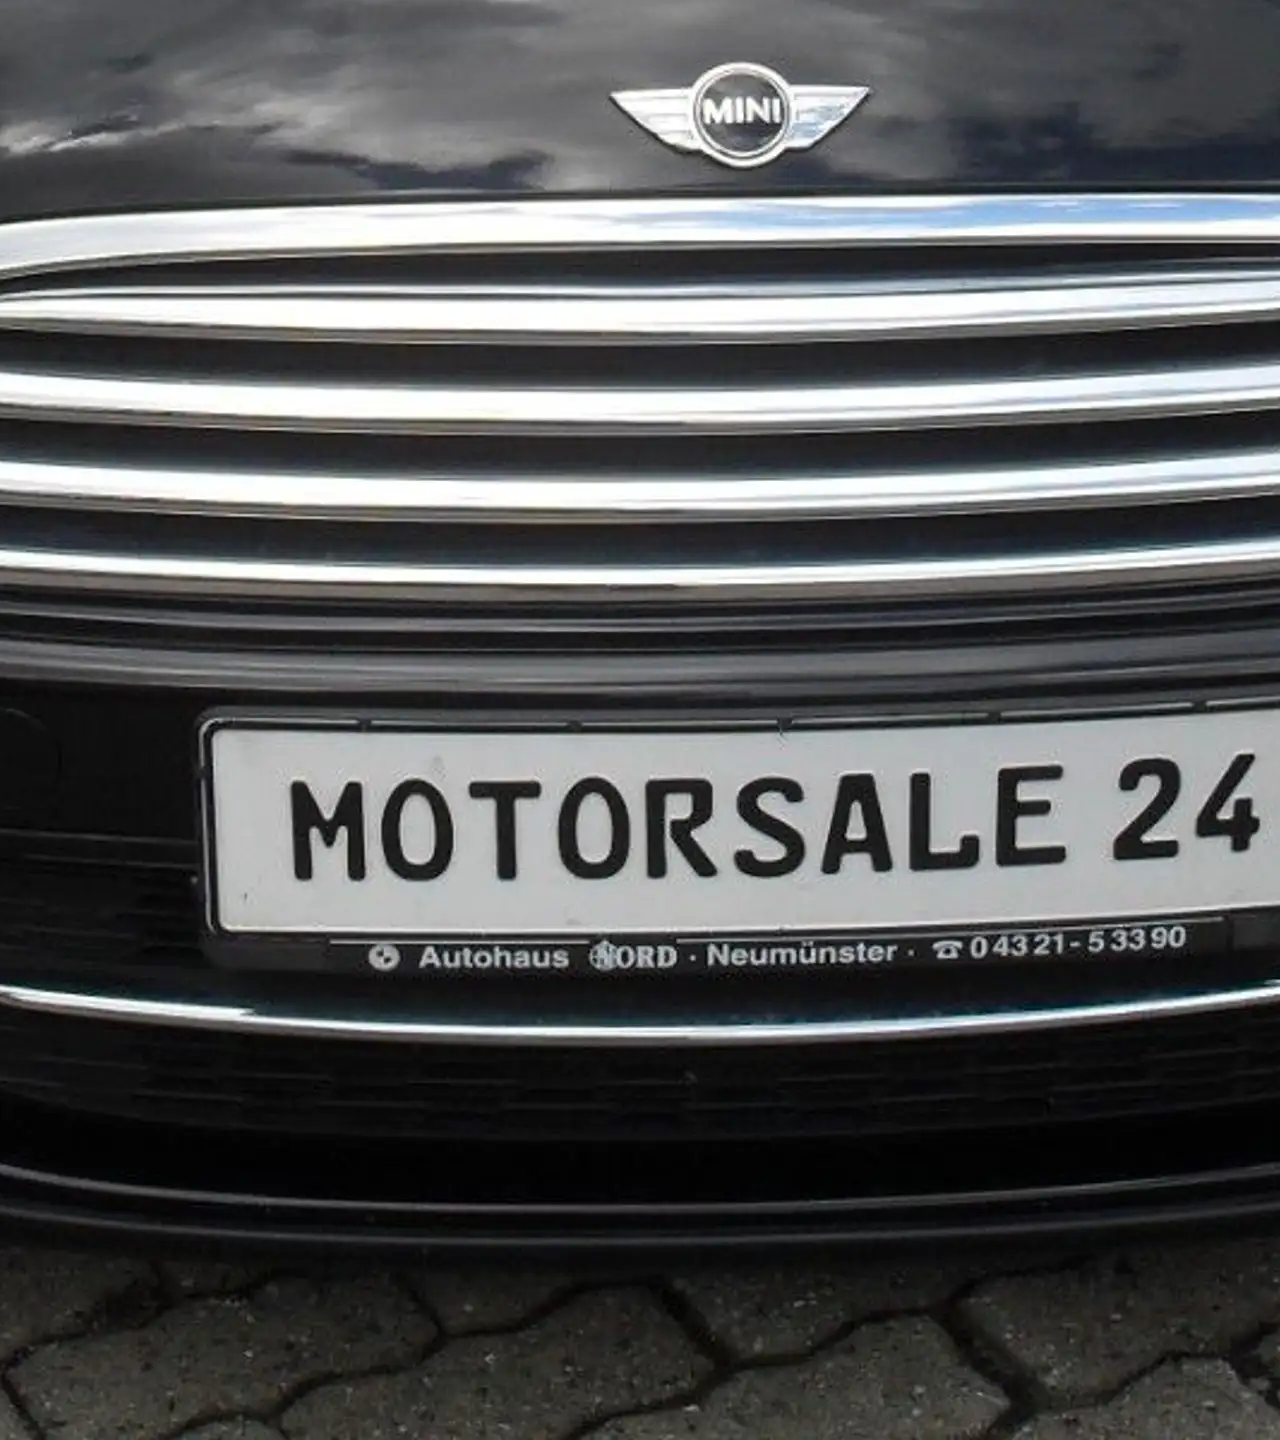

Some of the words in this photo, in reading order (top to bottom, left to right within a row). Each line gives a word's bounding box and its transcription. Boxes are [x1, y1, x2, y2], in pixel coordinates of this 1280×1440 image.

[700, 96, 783, 125] MINI
[289, 762, 1068, 883] MOTORSALE
[1112, 751, 1261, 862] 24
[418, 944, 570, 970] Autohaus
[706, 940, 899, 967] Neumünster
